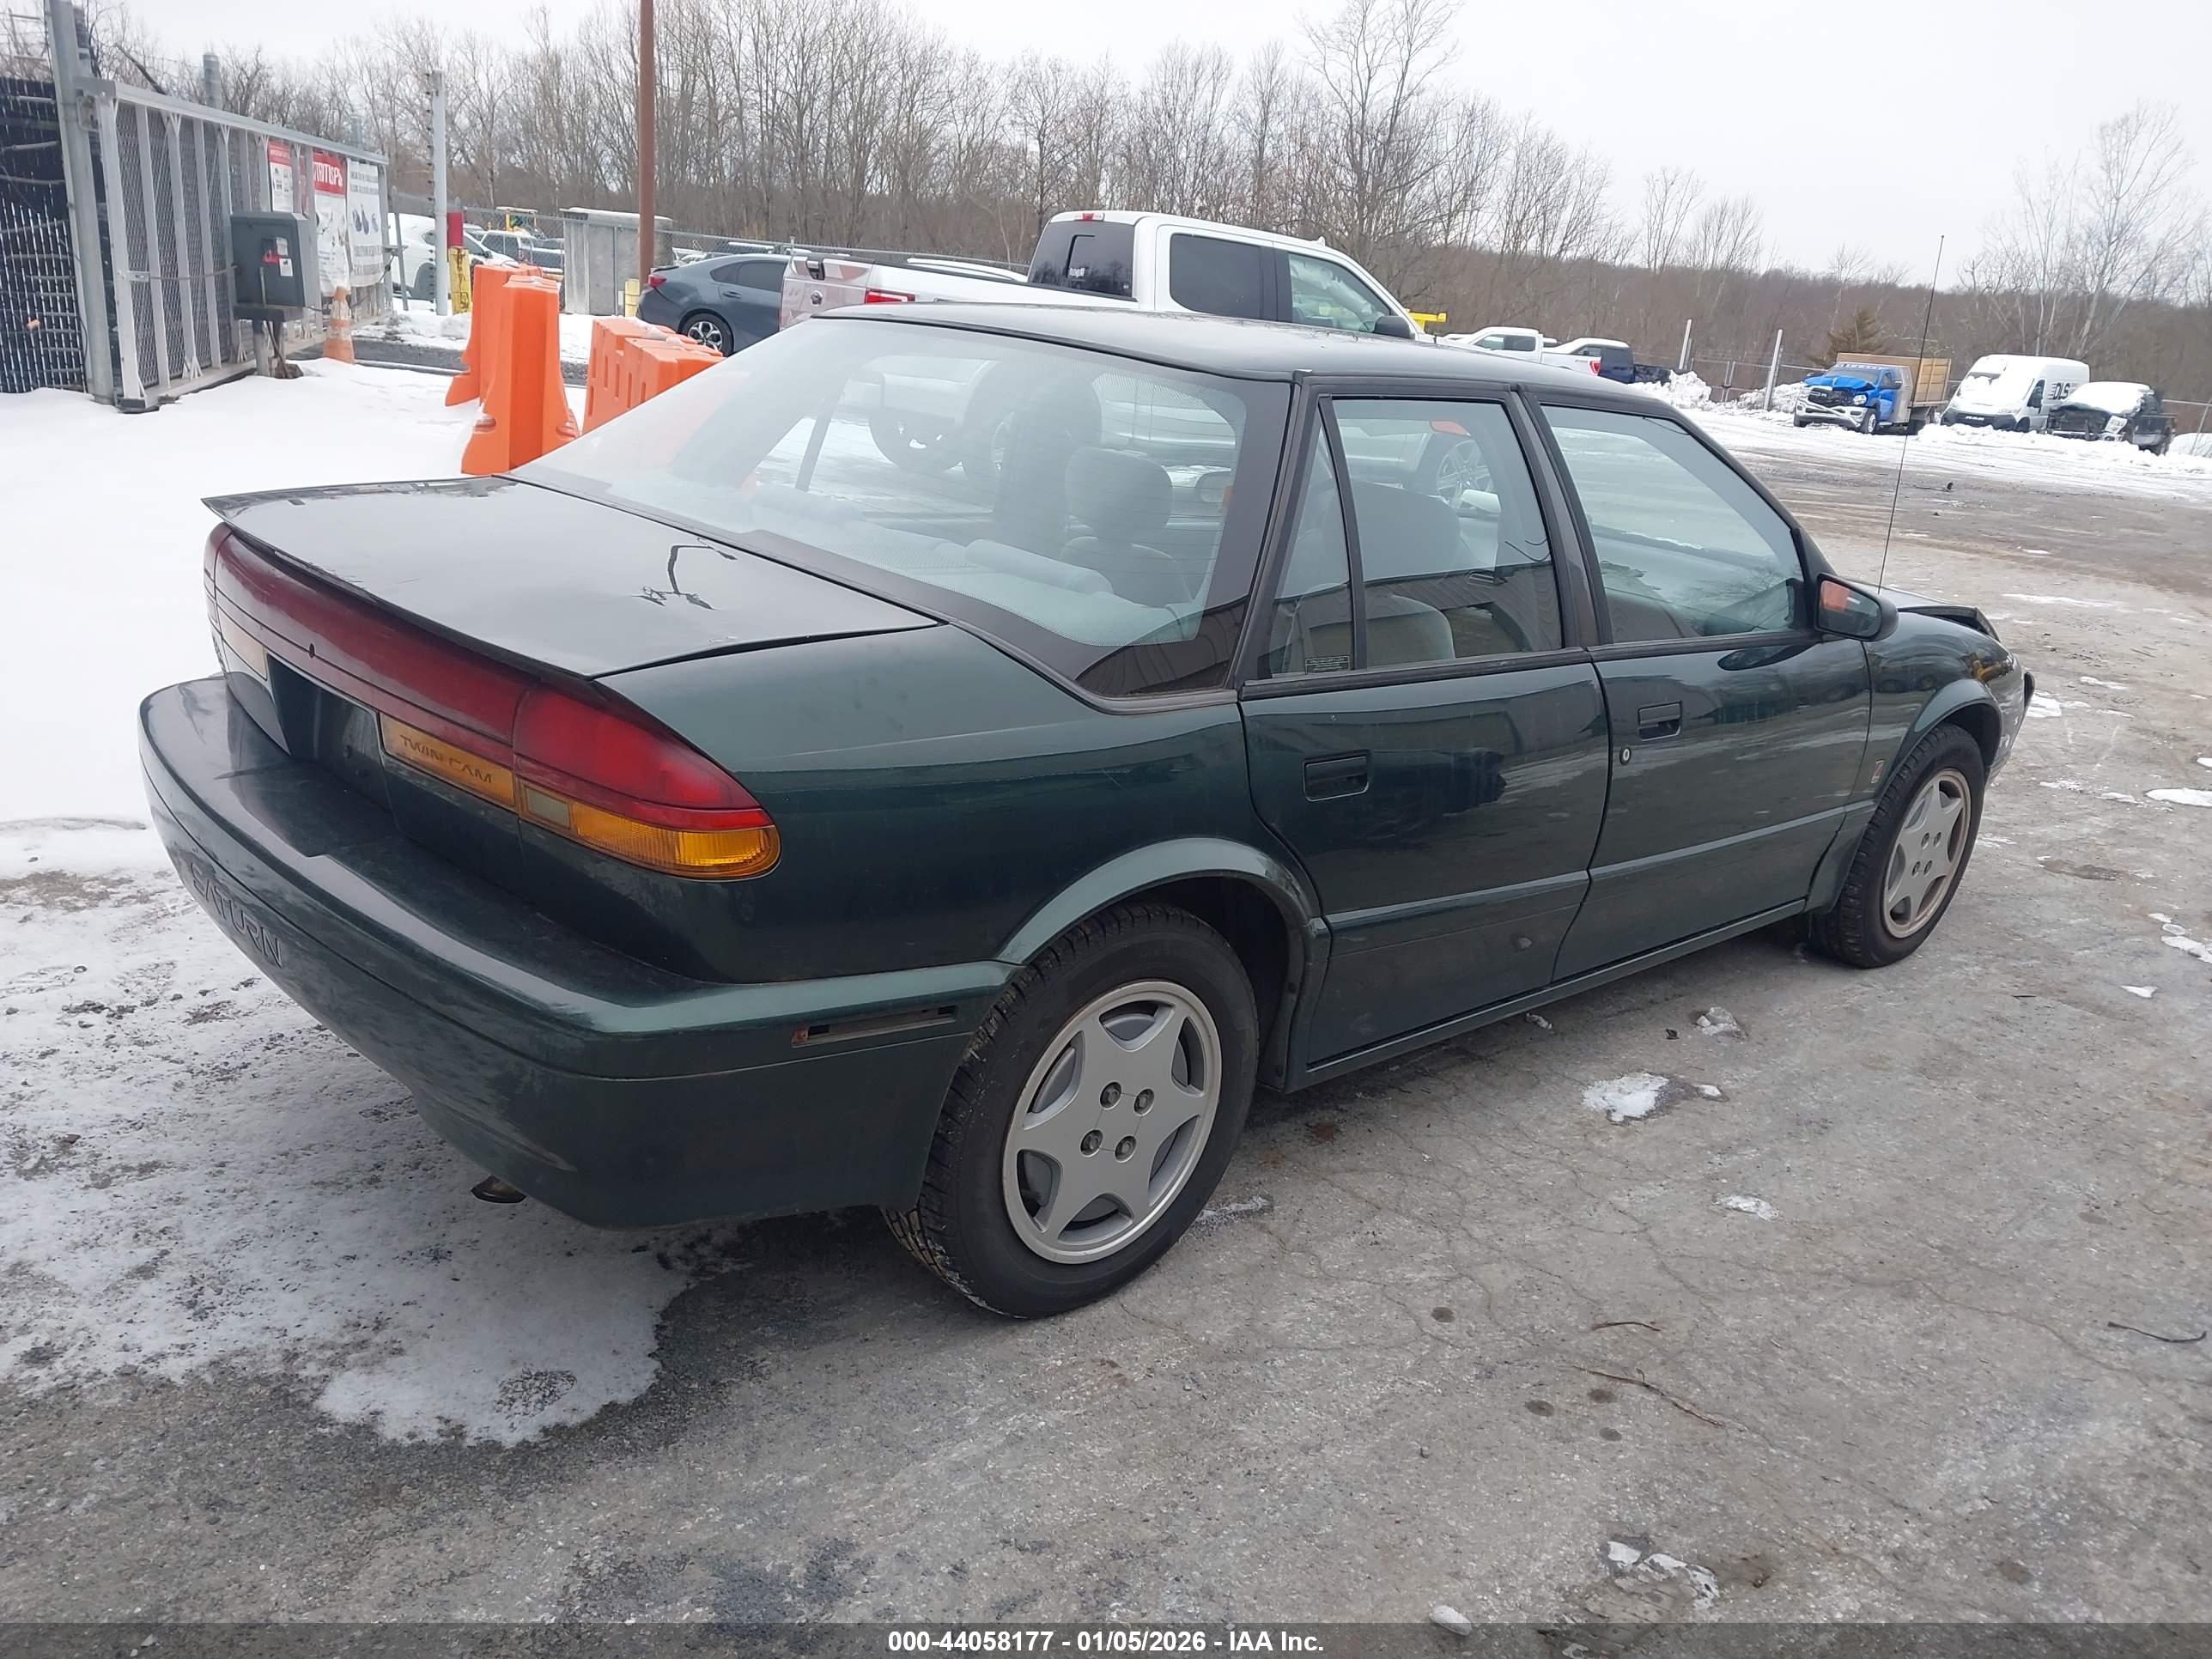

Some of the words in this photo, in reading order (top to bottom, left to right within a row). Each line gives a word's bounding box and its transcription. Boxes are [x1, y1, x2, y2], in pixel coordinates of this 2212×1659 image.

[399, 733, 444, 763] TWIN
[448, 757, 493, 784] CAM
[191, 862, 283, 969] SATURN
